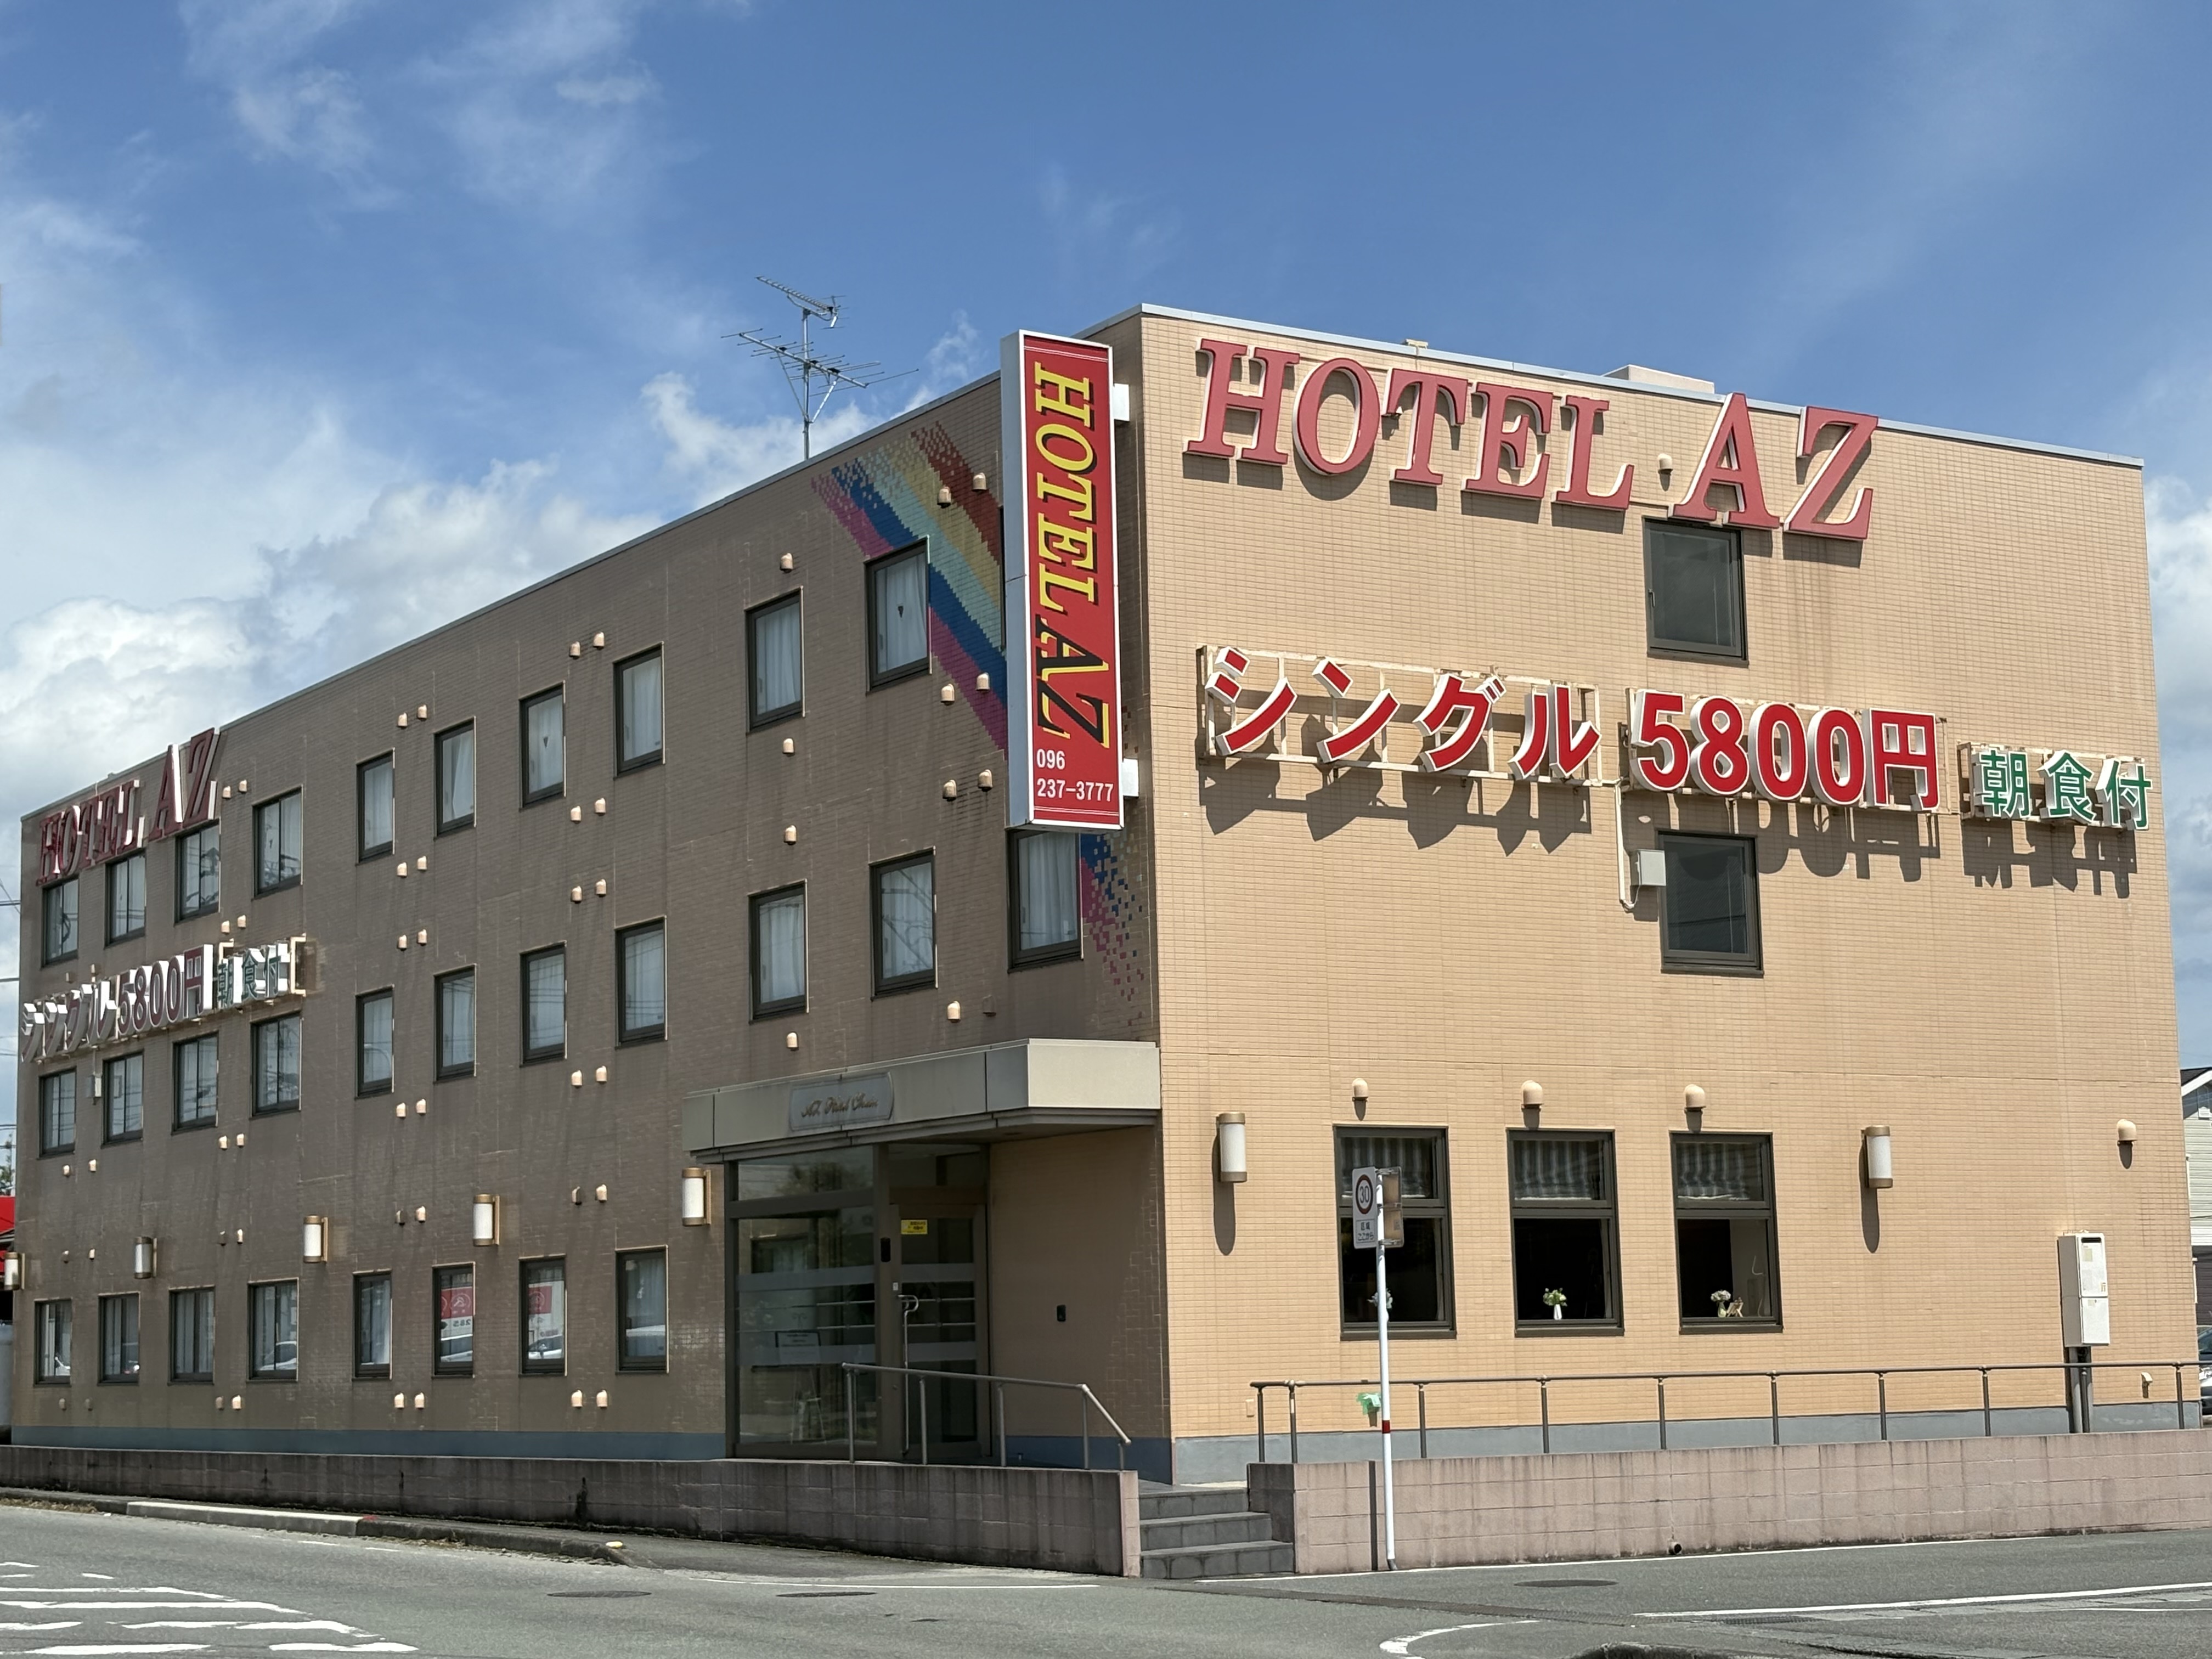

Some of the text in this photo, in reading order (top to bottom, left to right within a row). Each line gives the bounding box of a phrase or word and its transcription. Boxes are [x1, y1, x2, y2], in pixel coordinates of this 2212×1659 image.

[1183, 338, 1878, 540] HOTEL AZ
[1035, 360, 1111, 749] HOTEL AZ
[36, 727, 220, 887] HOTEL AZ
[1036, 748, 1066, 770] 096
[1036, 777, 1114, 803] 237-3777
[1206, 646, 2153, 831] シングル 5800円 朝食付
[1359, 1186, 1370, 1204] 30
